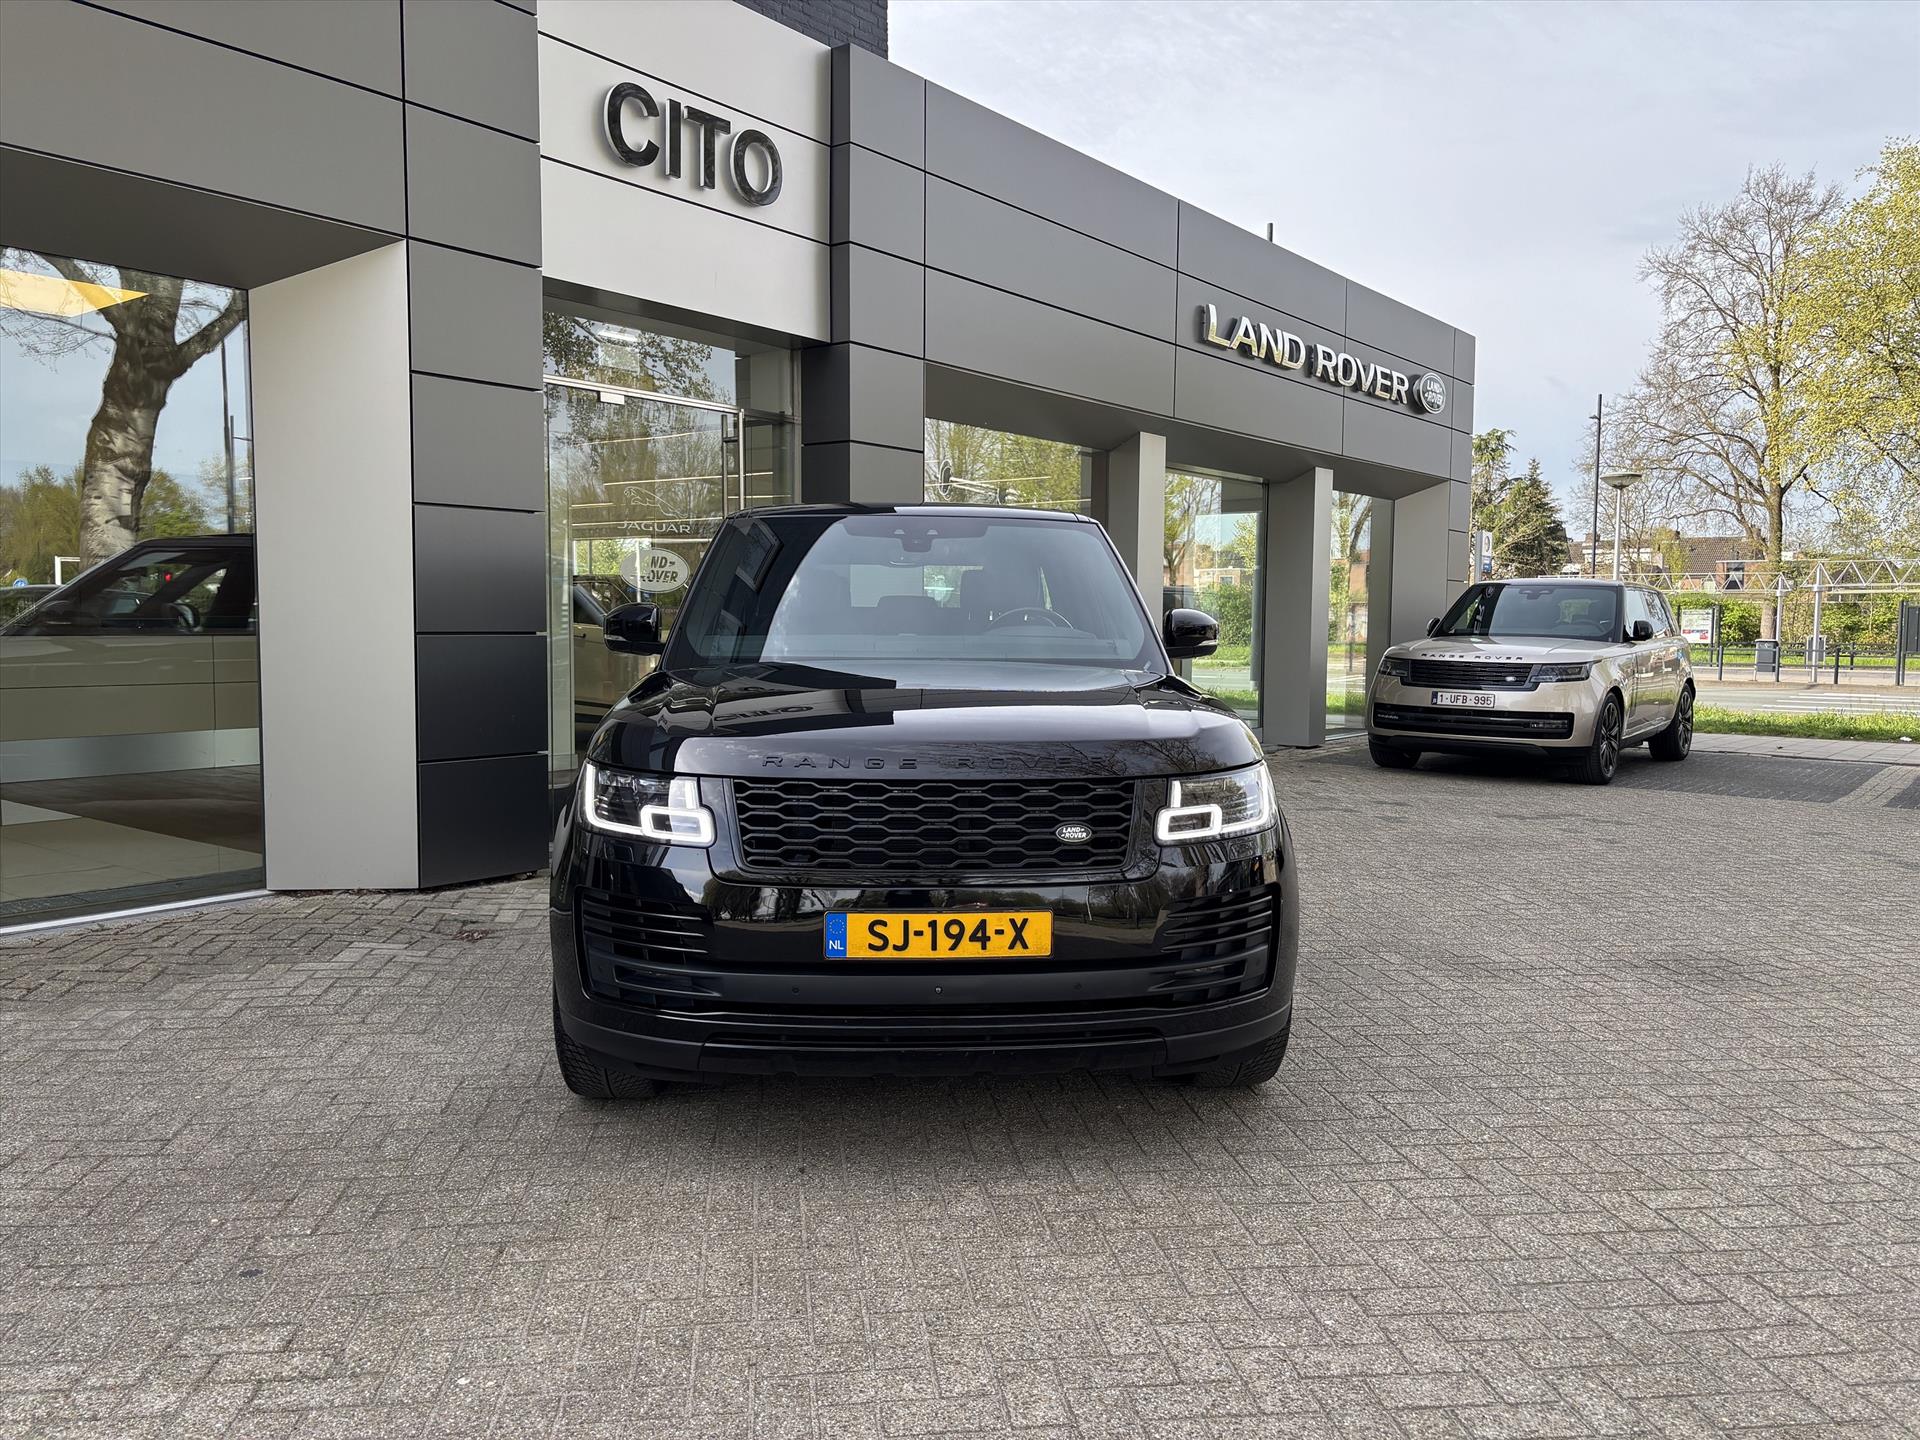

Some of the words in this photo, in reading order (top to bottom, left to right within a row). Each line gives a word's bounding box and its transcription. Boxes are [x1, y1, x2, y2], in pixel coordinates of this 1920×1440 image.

[603, 82, 783, 206] CITO
[1205, 303, 1306, 370] LAND
[1315, 343, 1410, 404] ROVER
[617, 521, 691, 534] JAGUAR
[762, 756, 918, 769] RANGE
[956, 756, 1106, 769] ROVER
[828, 940, 844, 950] NL
[867, 918, 1029, 951] SJ-194-X
